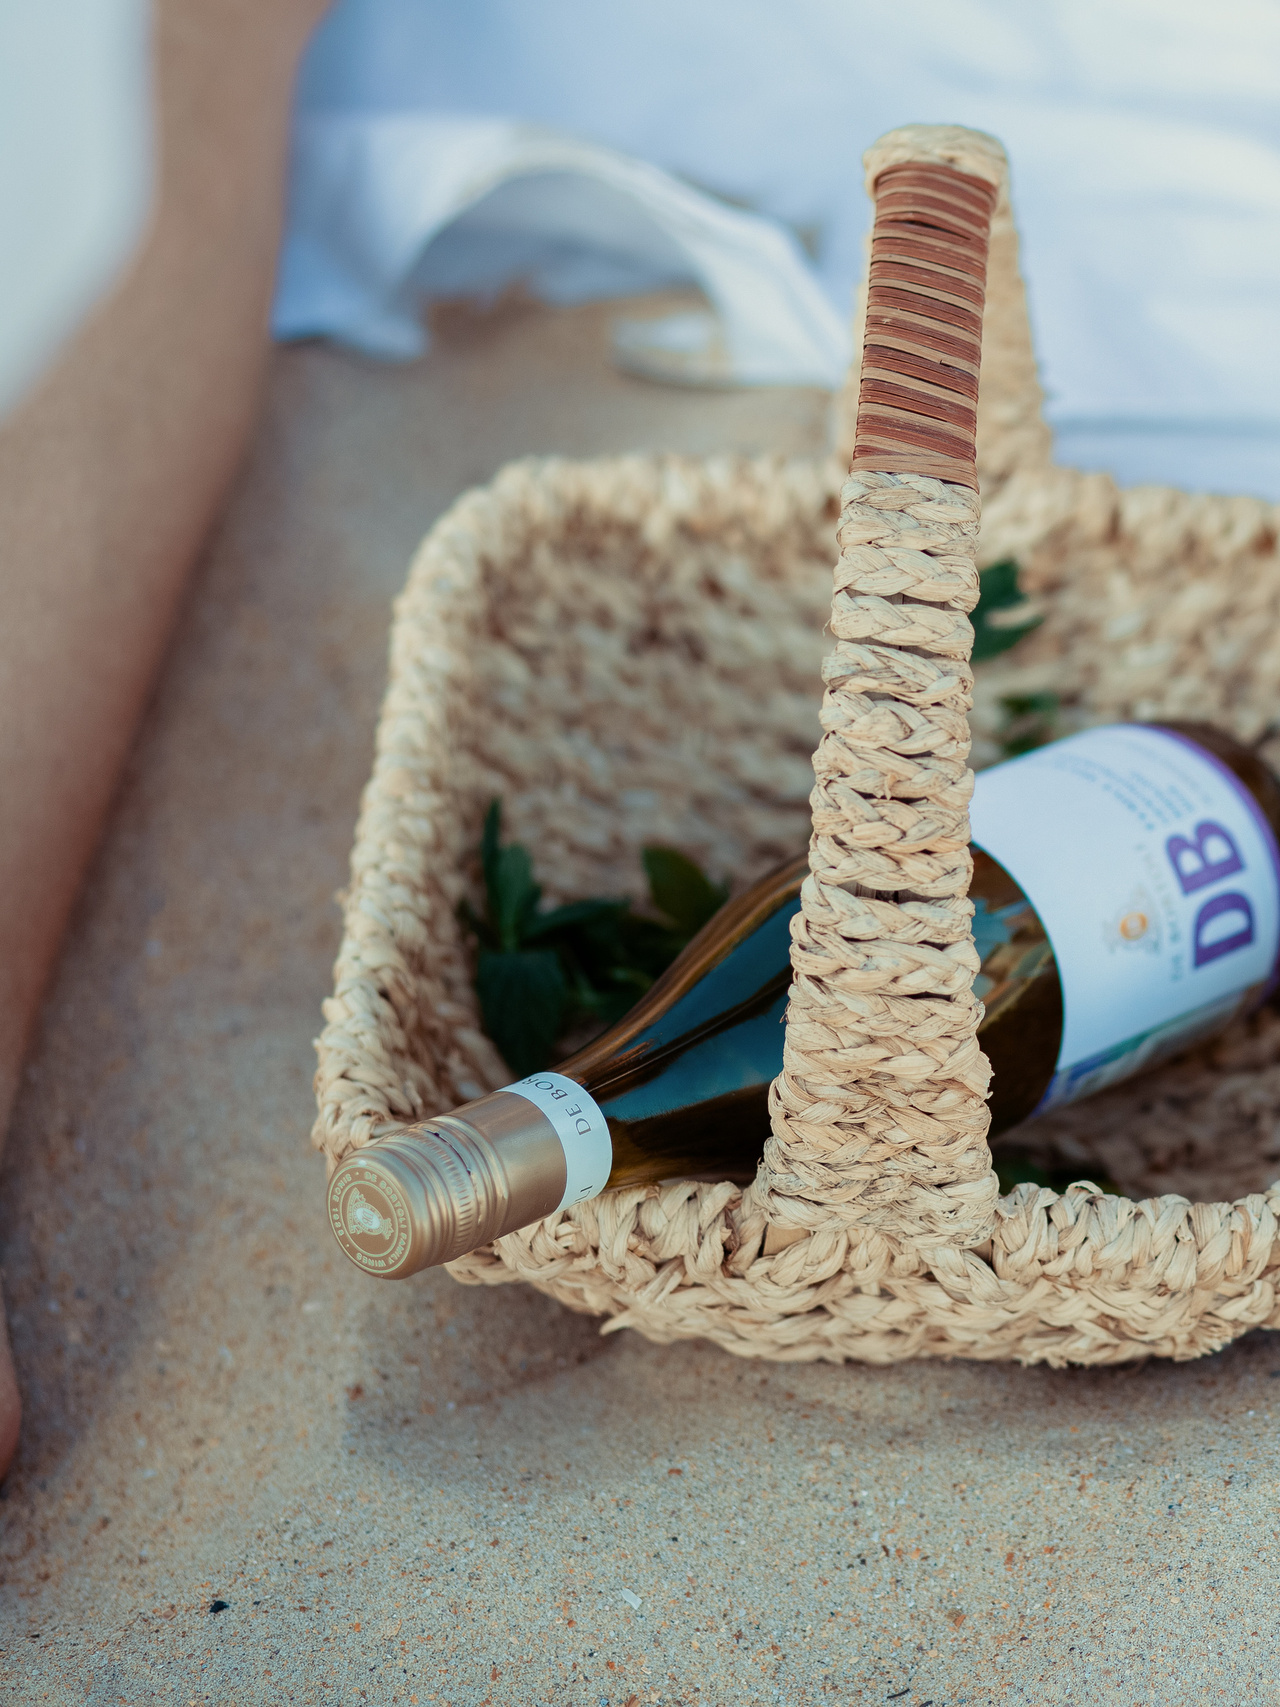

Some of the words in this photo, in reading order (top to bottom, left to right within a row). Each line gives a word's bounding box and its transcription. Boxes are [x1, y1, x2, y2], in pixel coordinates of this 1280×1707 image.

[1166, 820, 1254, 968] DB
[565, 1104, 592, 1135] DE
[332, 1173, 352, 1202] SINCE
[365, 1171, 378, 1182] DE
[379, 1181, 407, 1229] BORTOLI
[356, 1253, 387, 1268] WINES
[388, 1232, 407, 1264] FAMILY
